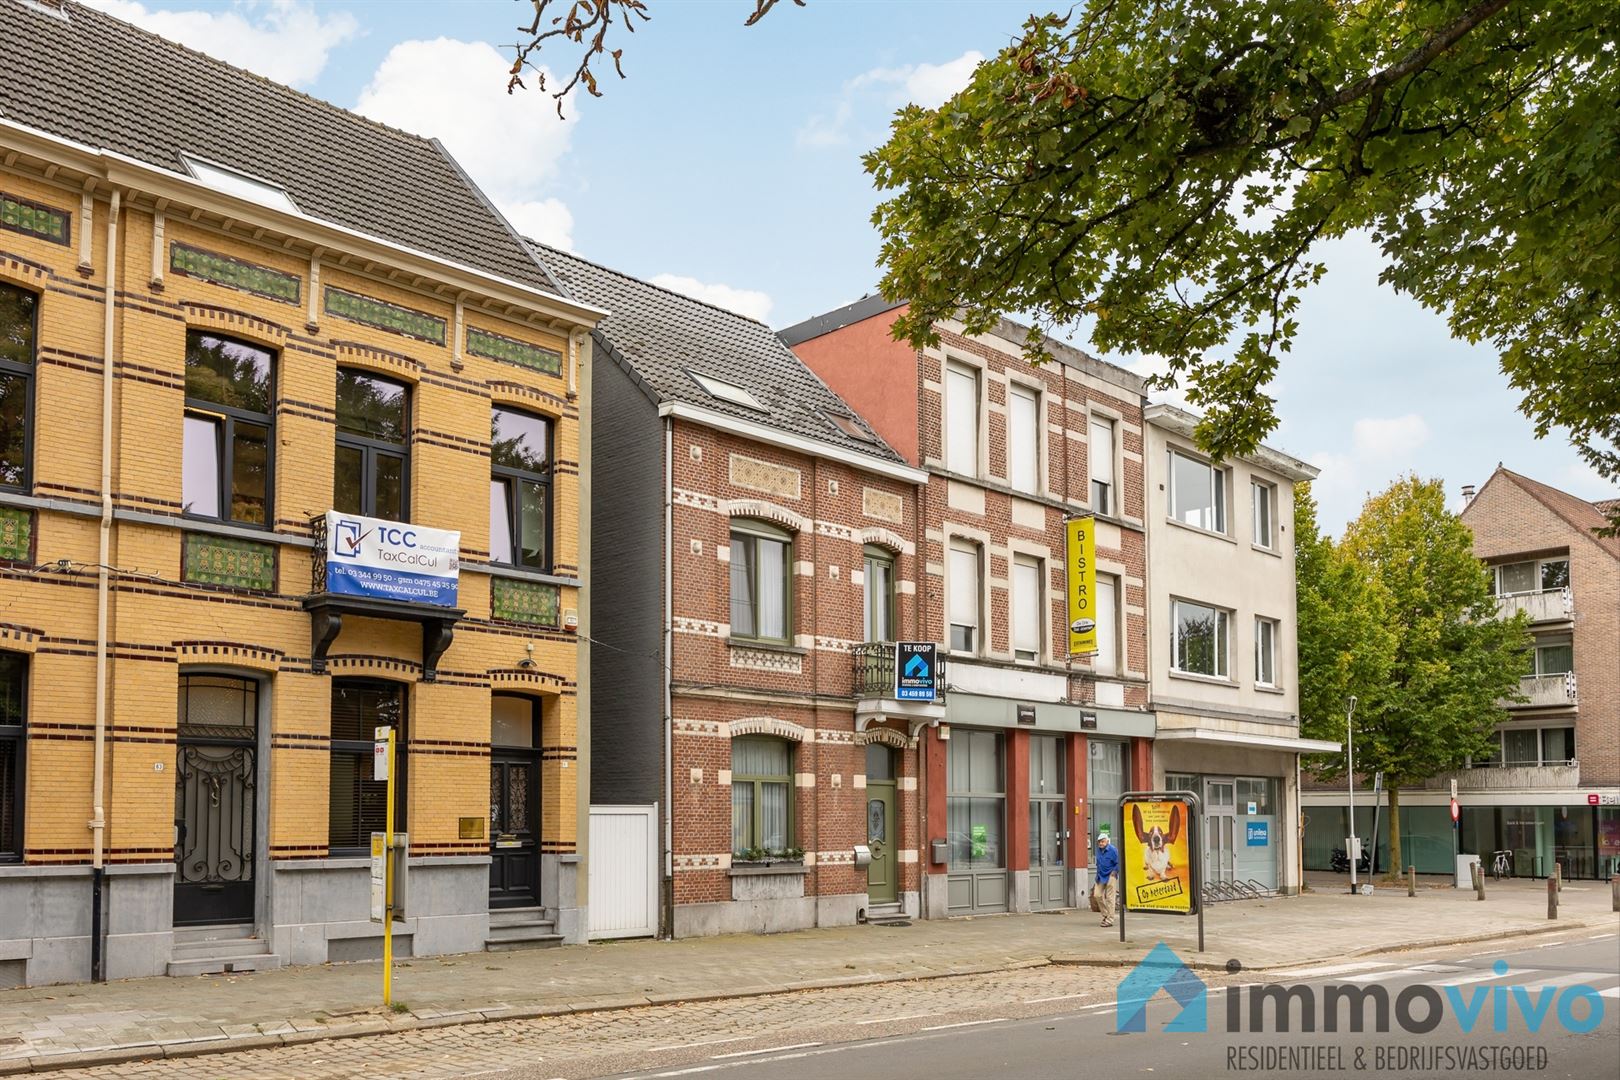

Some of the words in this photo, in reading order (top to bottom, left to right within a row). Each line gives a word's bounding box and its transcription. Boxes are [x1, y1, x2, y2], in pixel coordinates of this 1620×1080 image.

[378, 527, 417, 548] TCC
[378, 549, 437, 567] TaxCalCul
[347, 569, 357, 577] 03
[358, 570, 371, 579] 344
[372, 573, 382, 581] 99
[383, 574, 393, 582] 50
[398, 577, 413, 585] gsm
[414, 579, 431, 588] 0475
[432, 580, 441, 588] 45
[1077, 530, 1088, 609] BISTRO
[361, 581, 438, 597] WWW.TAXCALCUL.BE
[1141, 889, 1149, 900] Op
[1150, 882, 1177, 897] heterdaad
